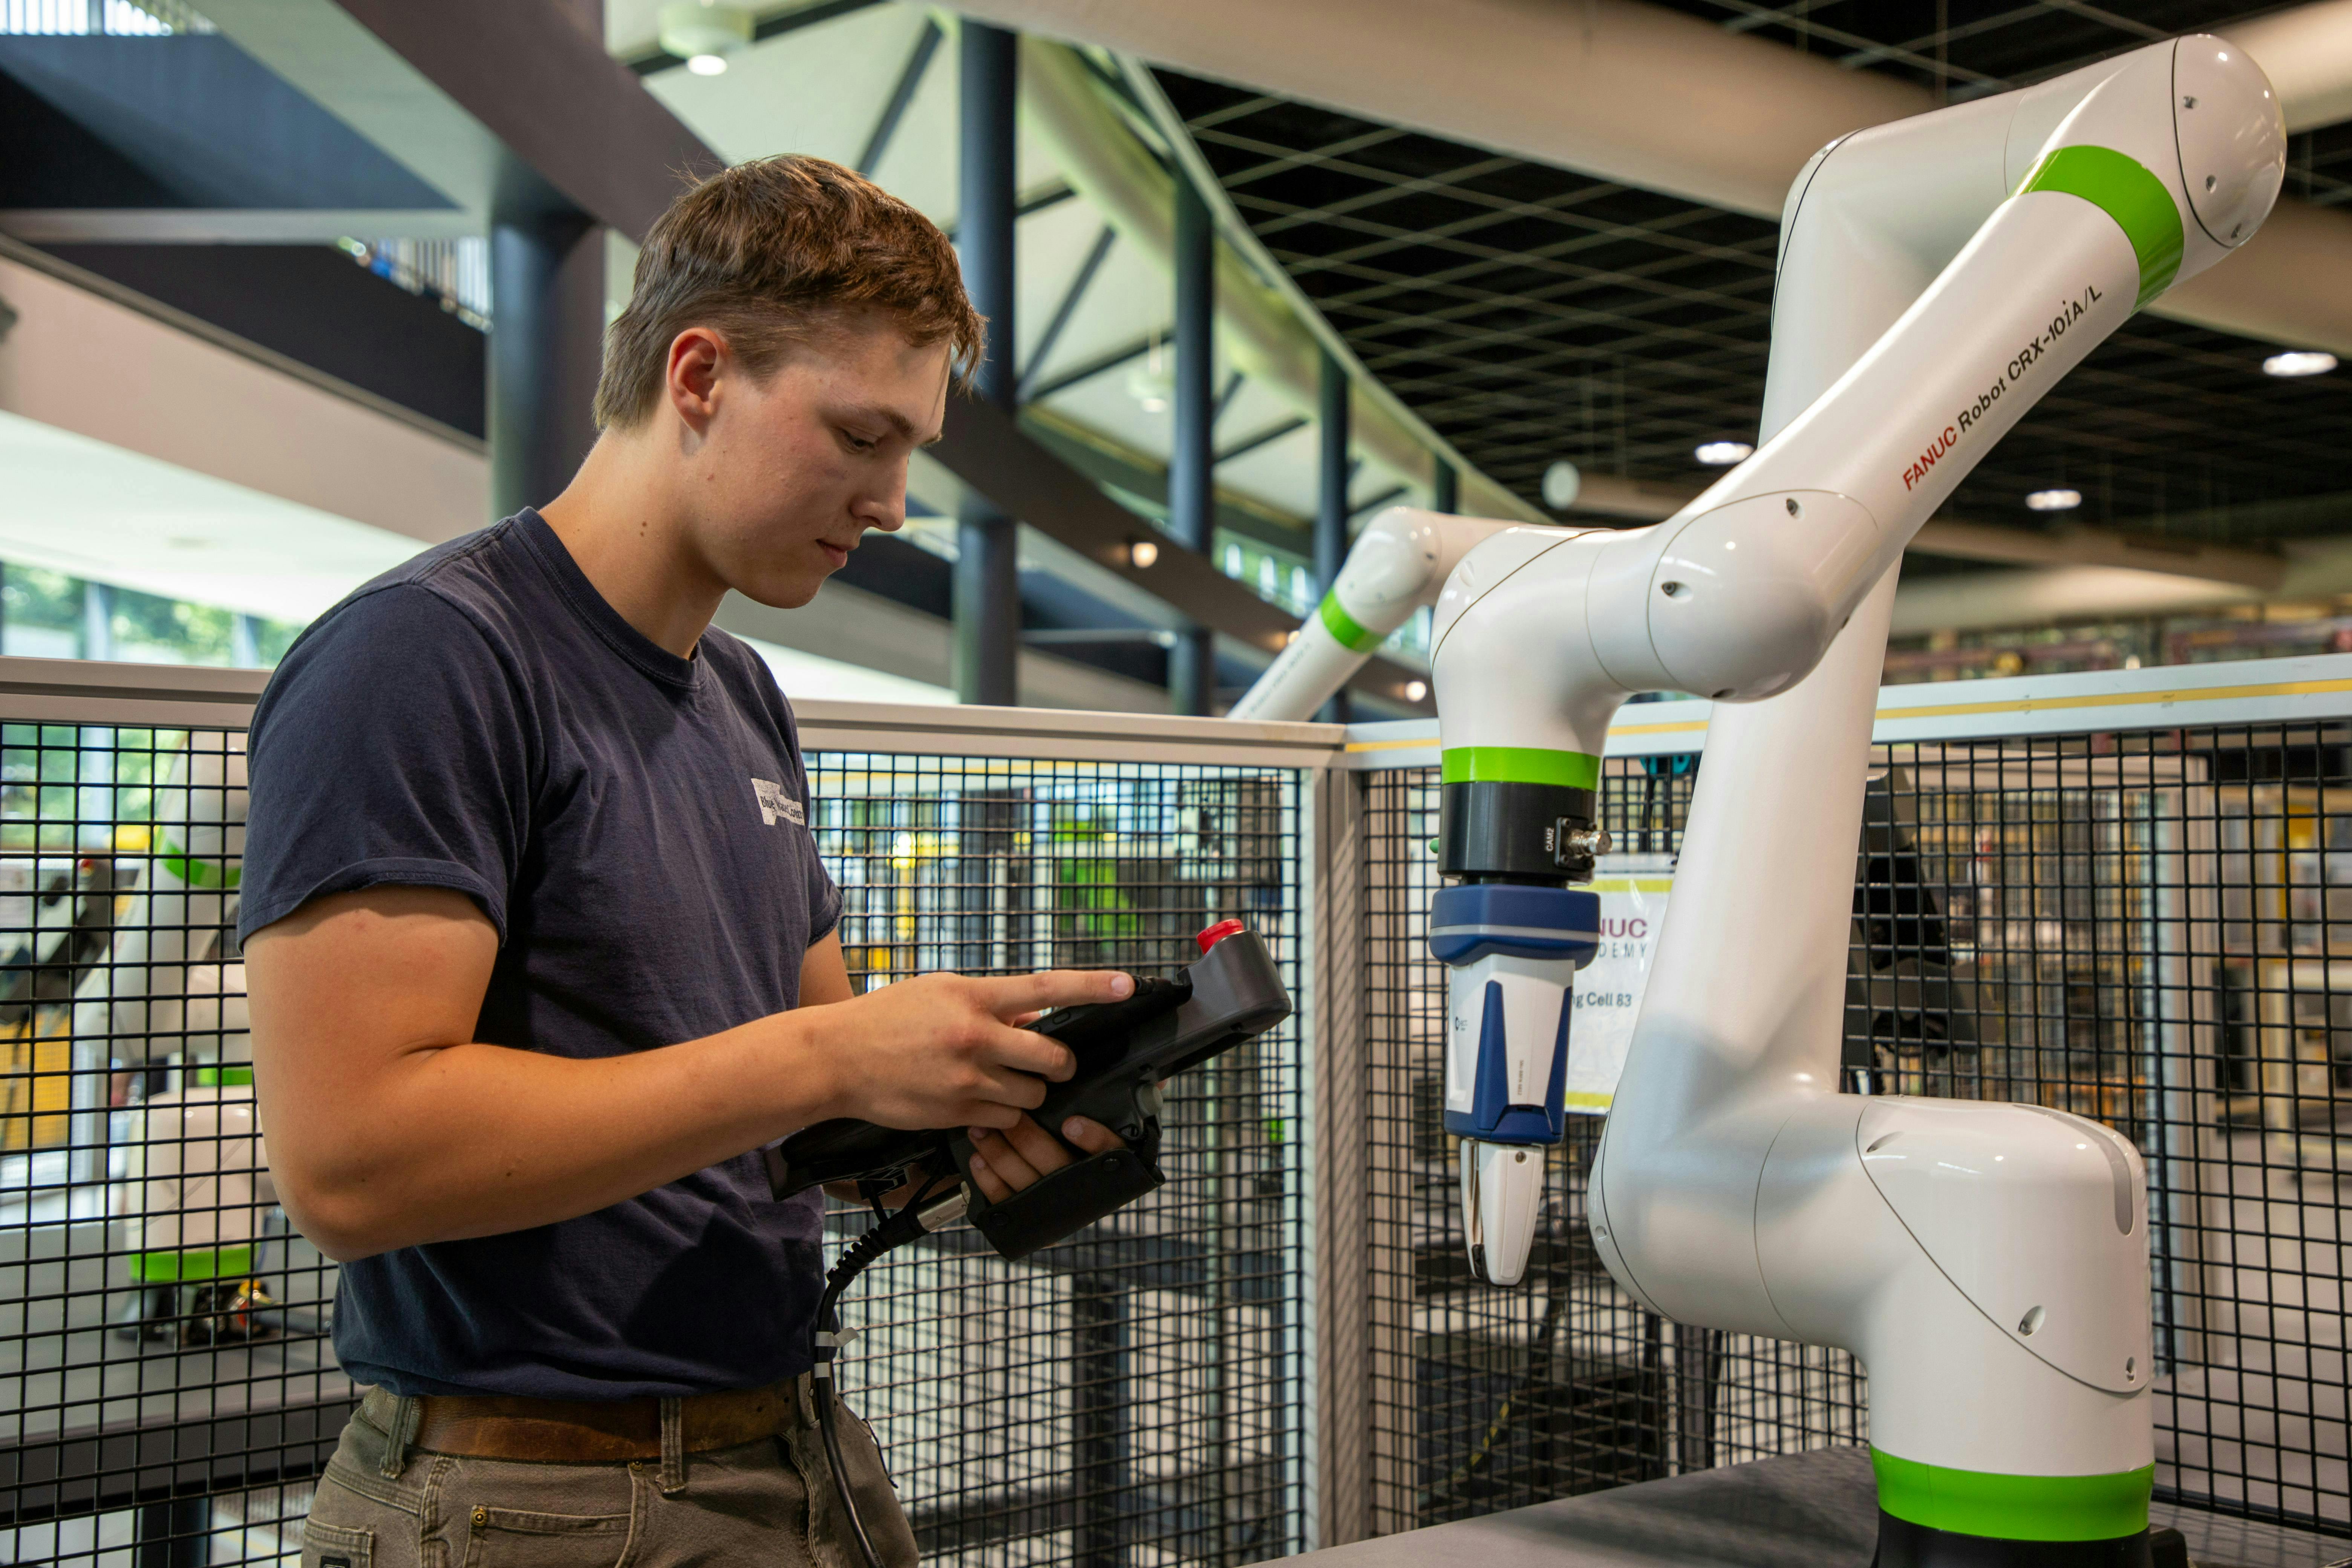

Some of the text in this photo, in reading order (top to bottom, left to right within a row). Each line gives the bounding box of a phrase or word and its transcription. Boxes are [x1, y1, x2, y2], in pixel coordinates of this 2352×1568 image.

[1902, 285, 2102, 491] FANUC Robot CRX-10iA/L
[1546, 827, 1554, 851] CAM2
[1587, 992, 1613, 1006] Cell
[1616, 993, 1632, 1007] 83
